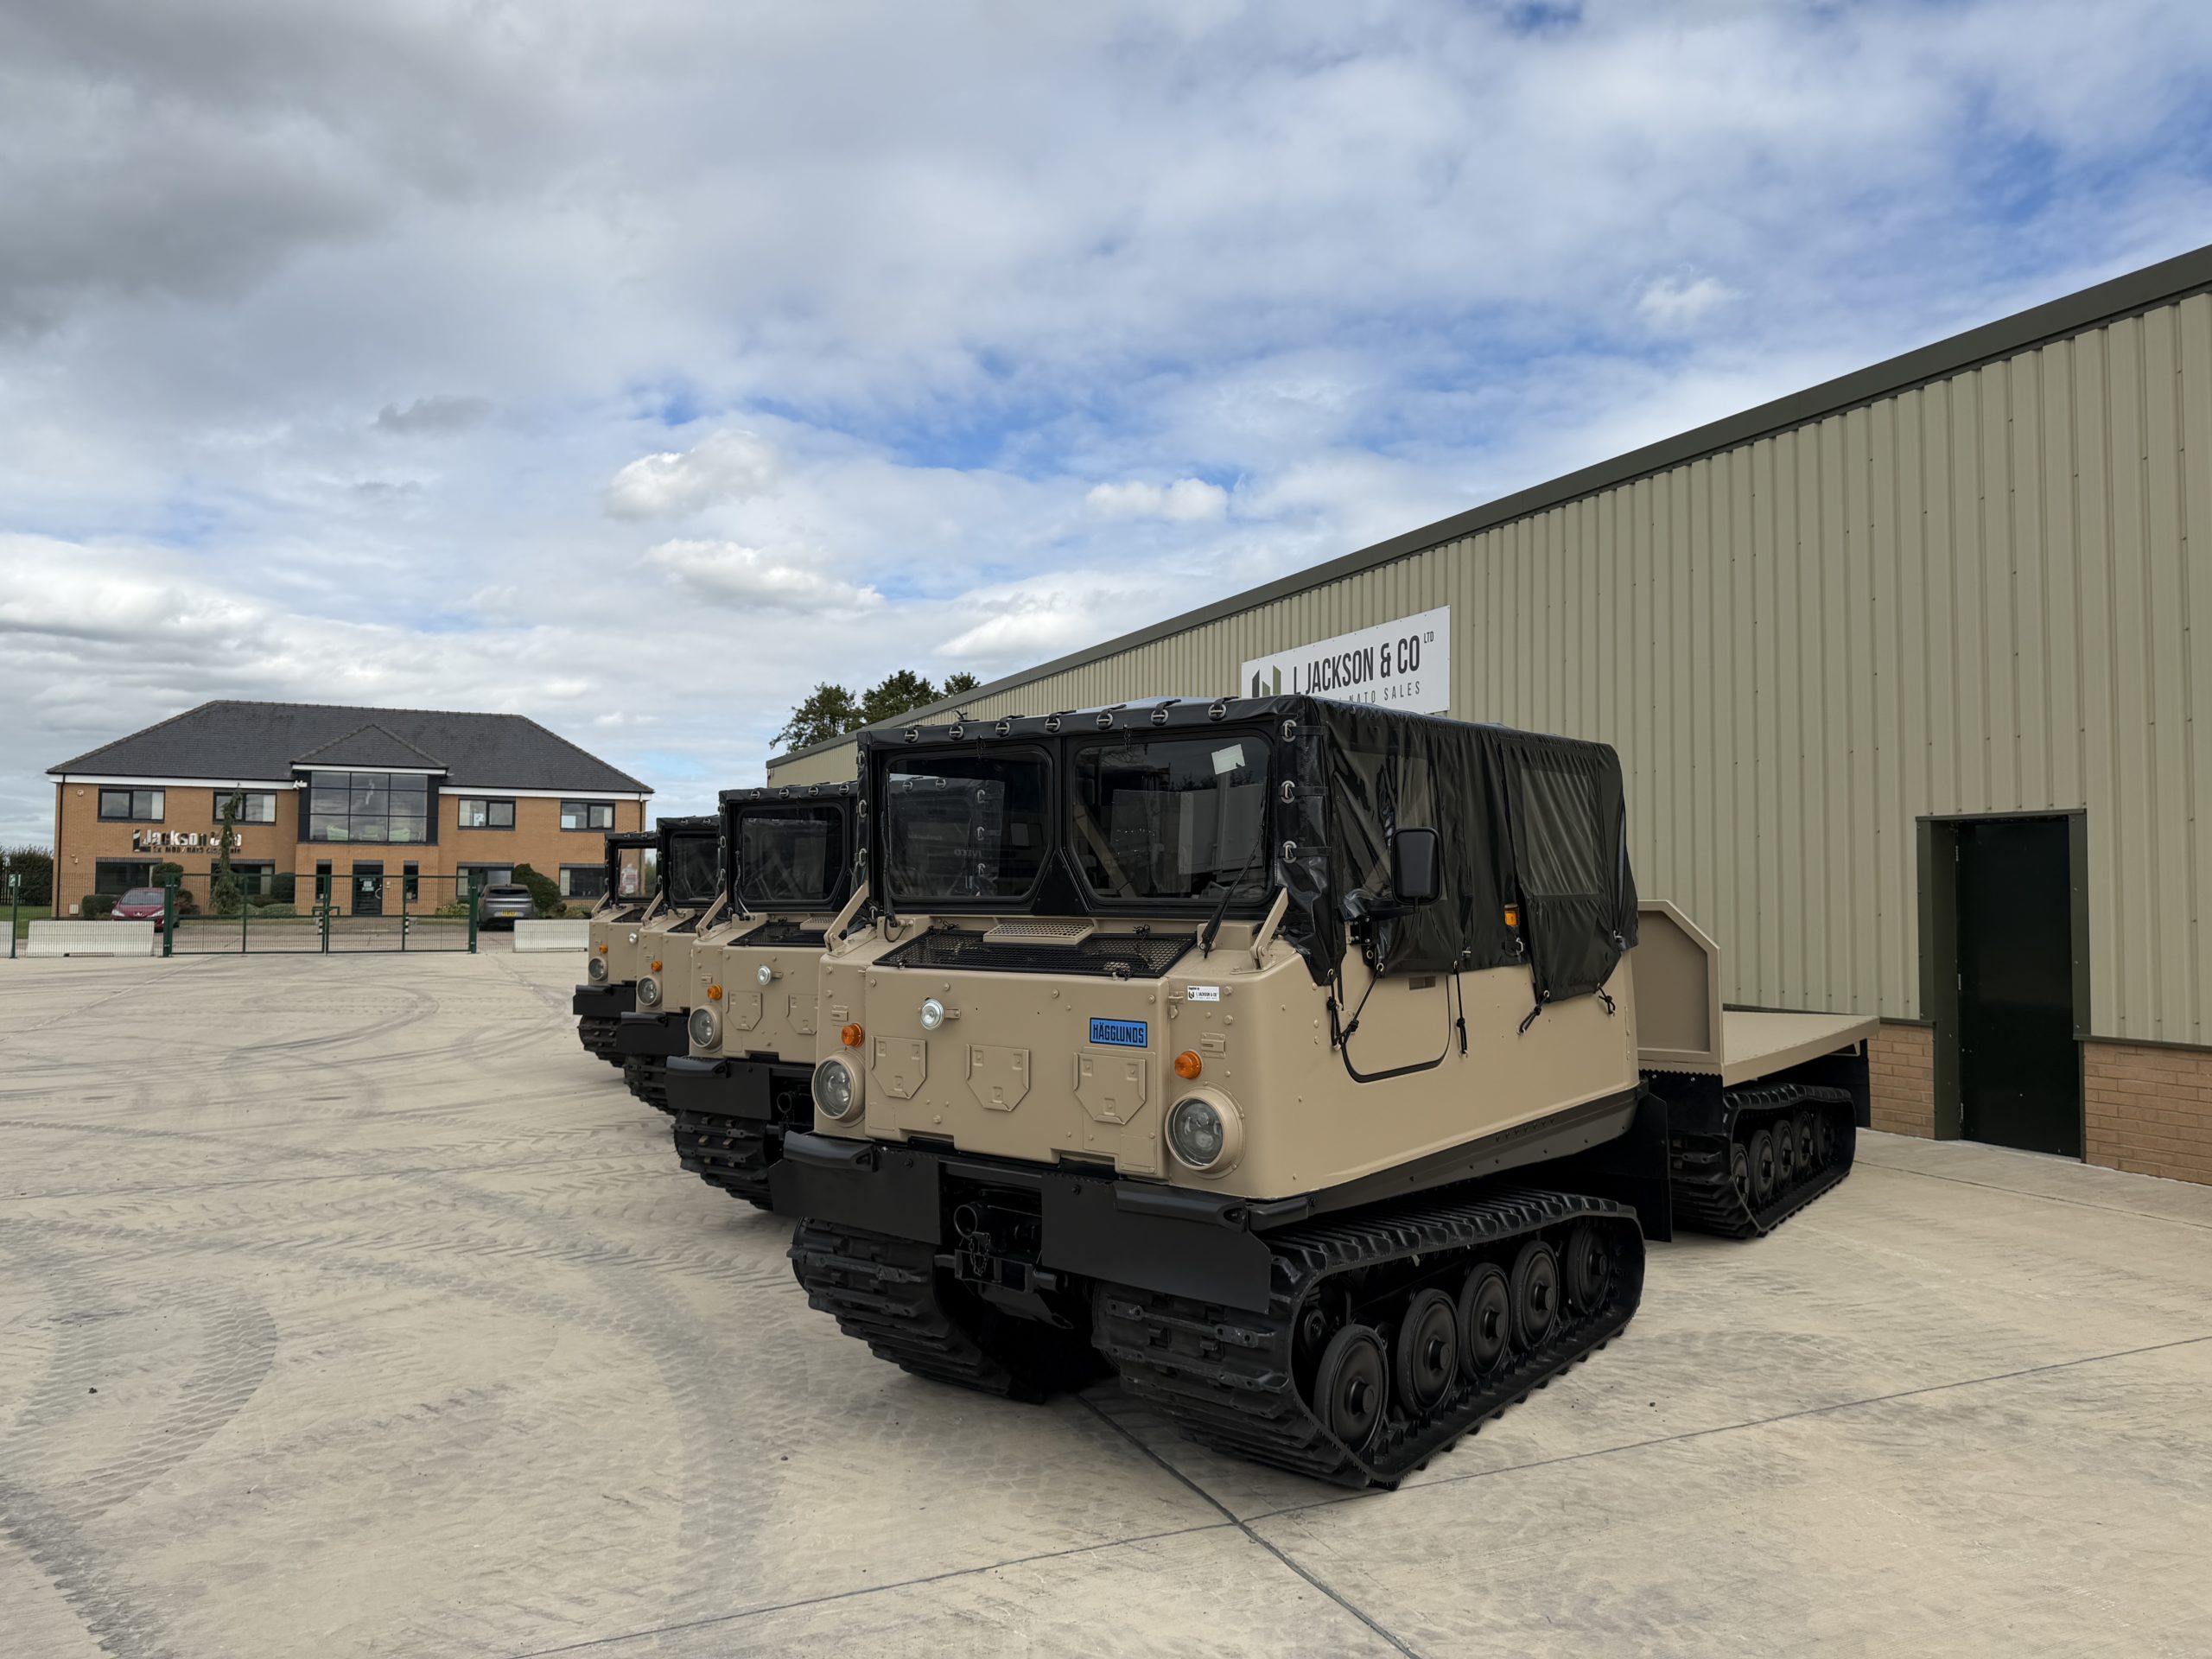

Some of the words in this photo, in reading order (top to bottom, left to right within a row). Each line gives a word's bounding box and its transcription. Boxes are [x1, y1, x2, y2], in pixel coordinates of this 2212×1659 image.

[1294, 666, 1301, 695] L
[1305, 646, 1374, 695] JACKSON
[1380, 643, 1391, 678] &
[1397, 635, 1421, 675] CO
[1423, 631, 1434, 644] LTD
[1384, 681, 1421, 701] SALES
[143, 830, 207, 847] Jackson
[1093, 1022, 1144, 1044] HÄGGLUNDS
